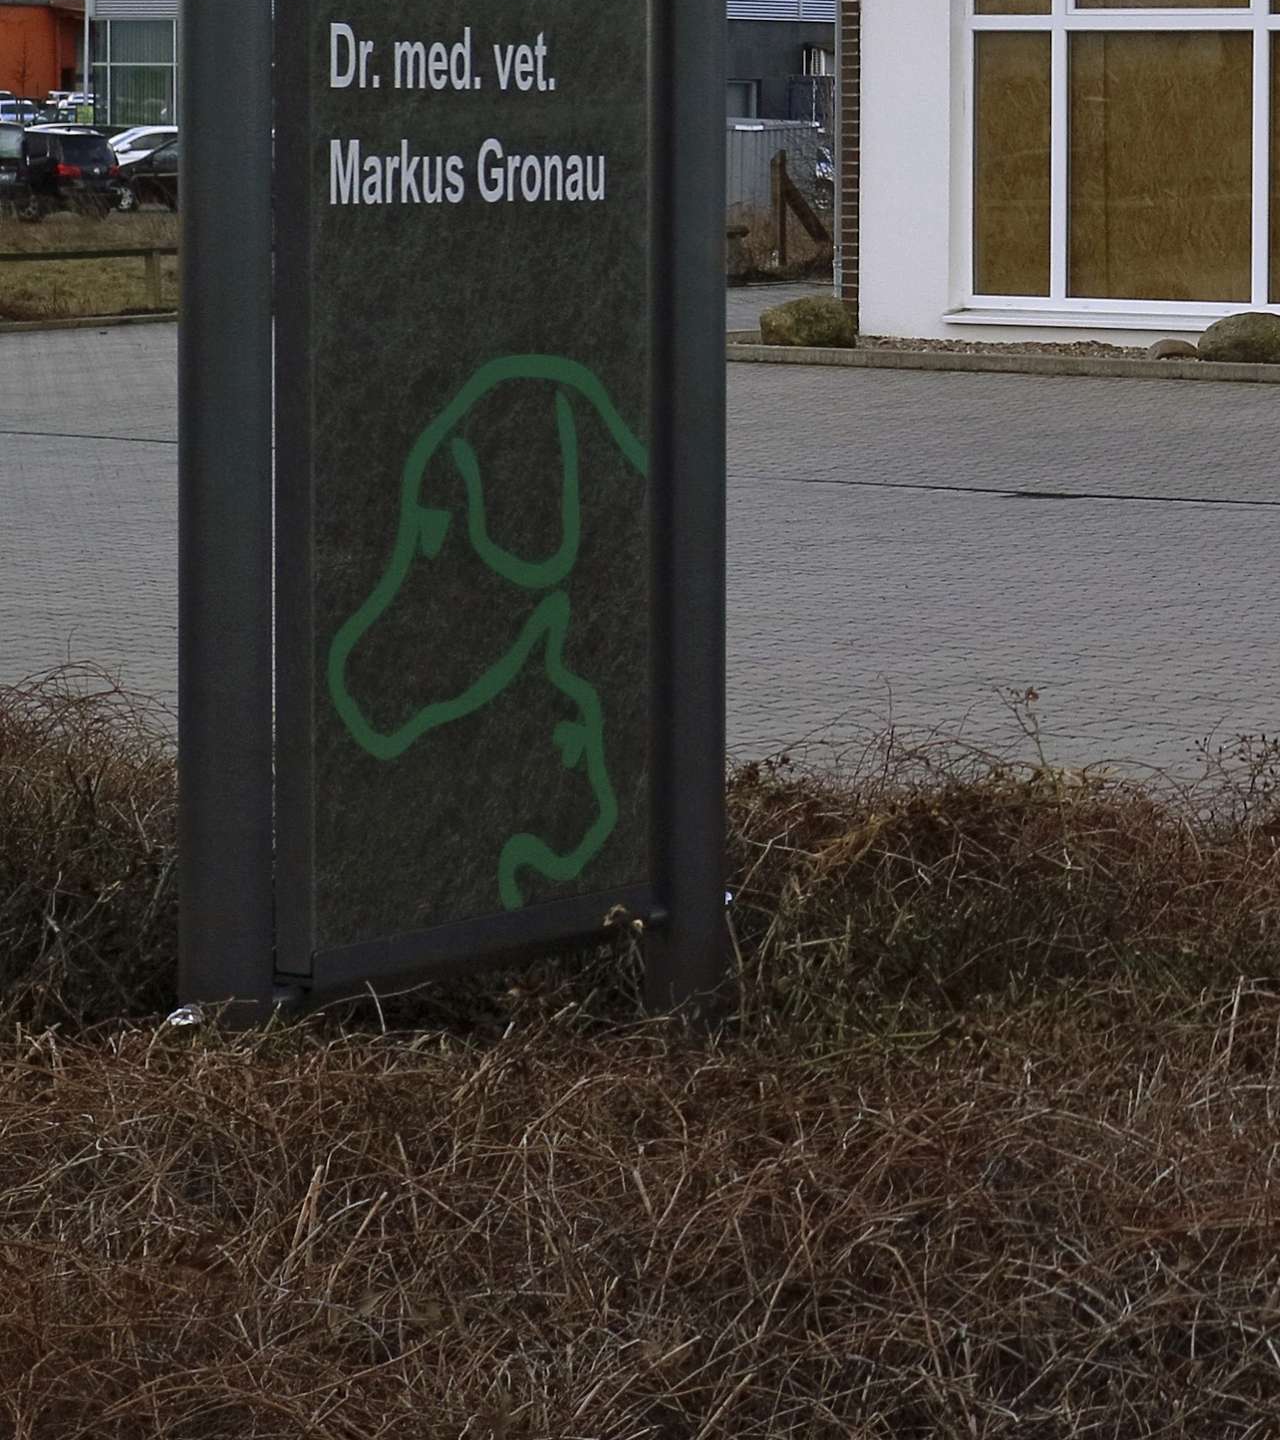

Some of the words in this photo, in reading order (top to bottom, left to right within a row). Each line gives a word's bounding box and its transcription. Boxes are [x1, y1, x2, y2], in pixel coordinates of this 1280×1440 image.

[329, 22, 380, 89] Dr.
[393, 26, 481, 90] med.
[493, 31, 556, 91] vet.
[329, 138, 465, 205] Markus
[476, 137, 606, 203] Gronau
